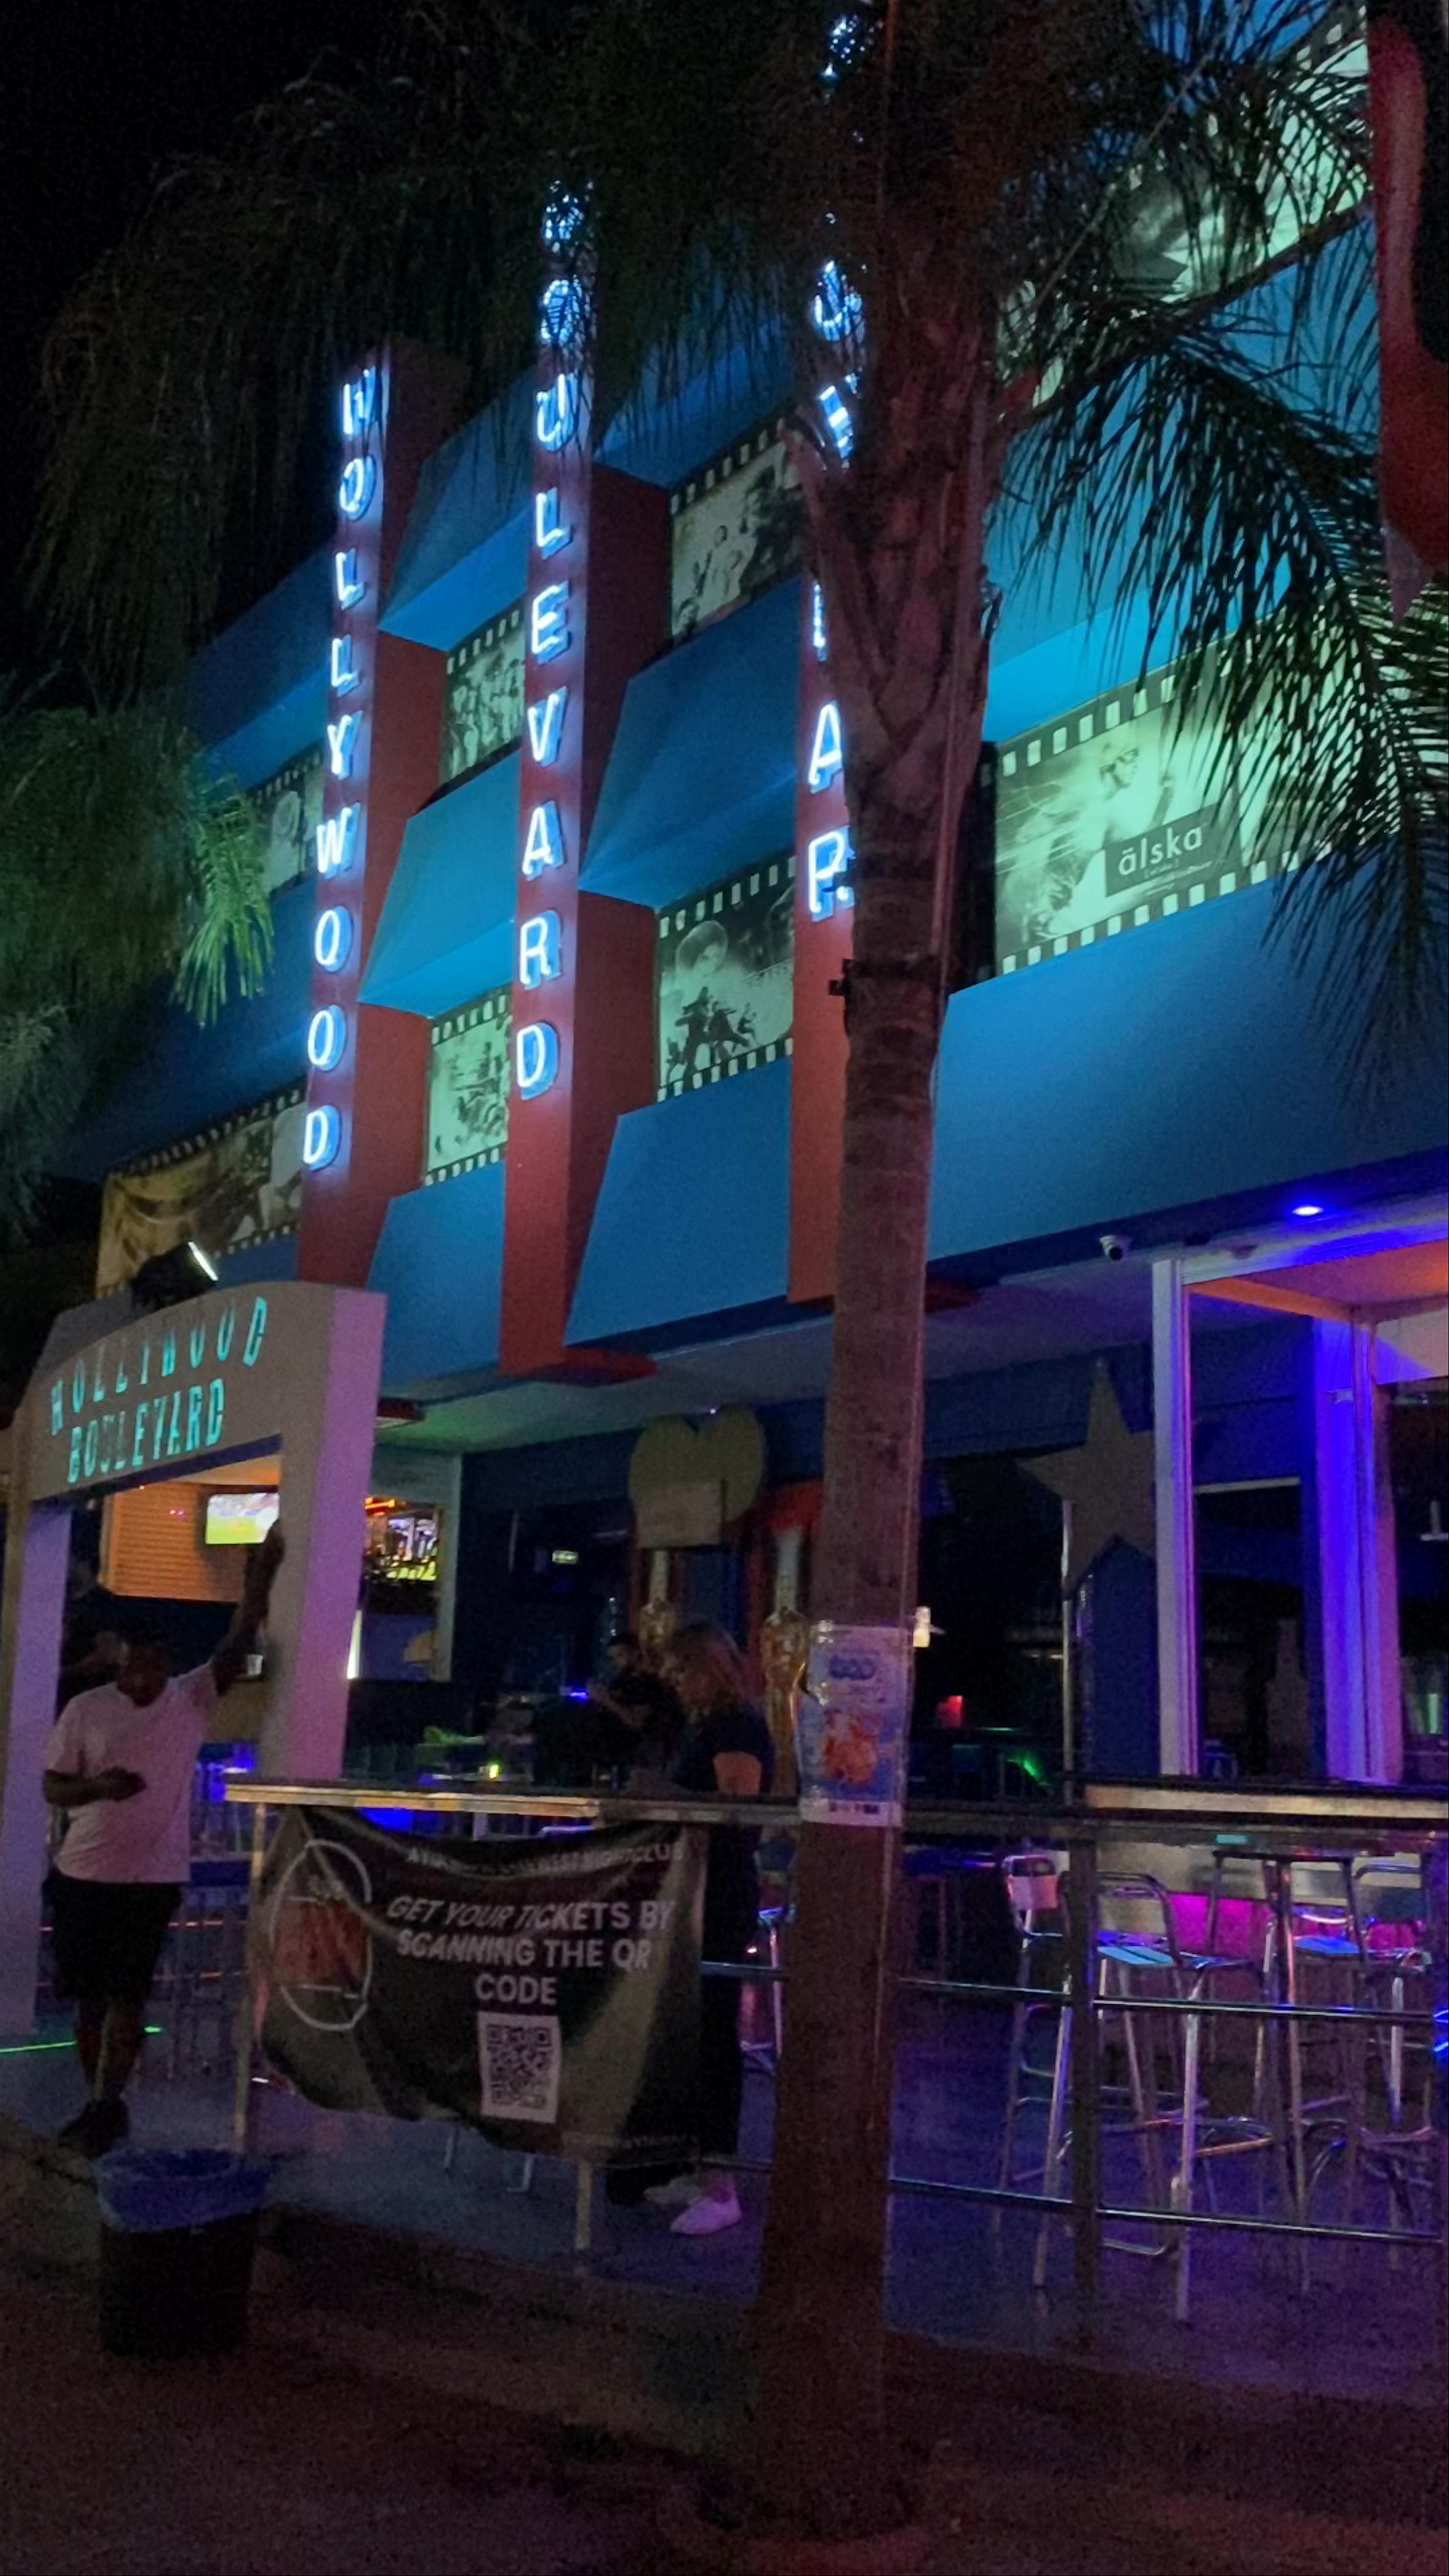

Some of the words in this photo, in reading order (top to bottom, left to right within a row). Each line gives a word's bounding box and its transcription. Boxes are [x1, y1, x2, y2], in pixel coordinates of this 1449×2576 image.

[302, 365, 377, 1171] HOLLYWOOD
[67, 1378, 225, 1483] BOULEVARD
[386, 1895, 445, 1923] GET
[445, 1902, 515, 1928] YOUR
[515, 1901, 632, 1930] TICKETS
[638, 1899, 675, 1930] BY
[395, 1929, 536, 1966] SCANNING
[543, 1939, 604, 1968] THE
[611, 1937, 652, 1970] QR
[474, 1973, 558, 2005] CODE
